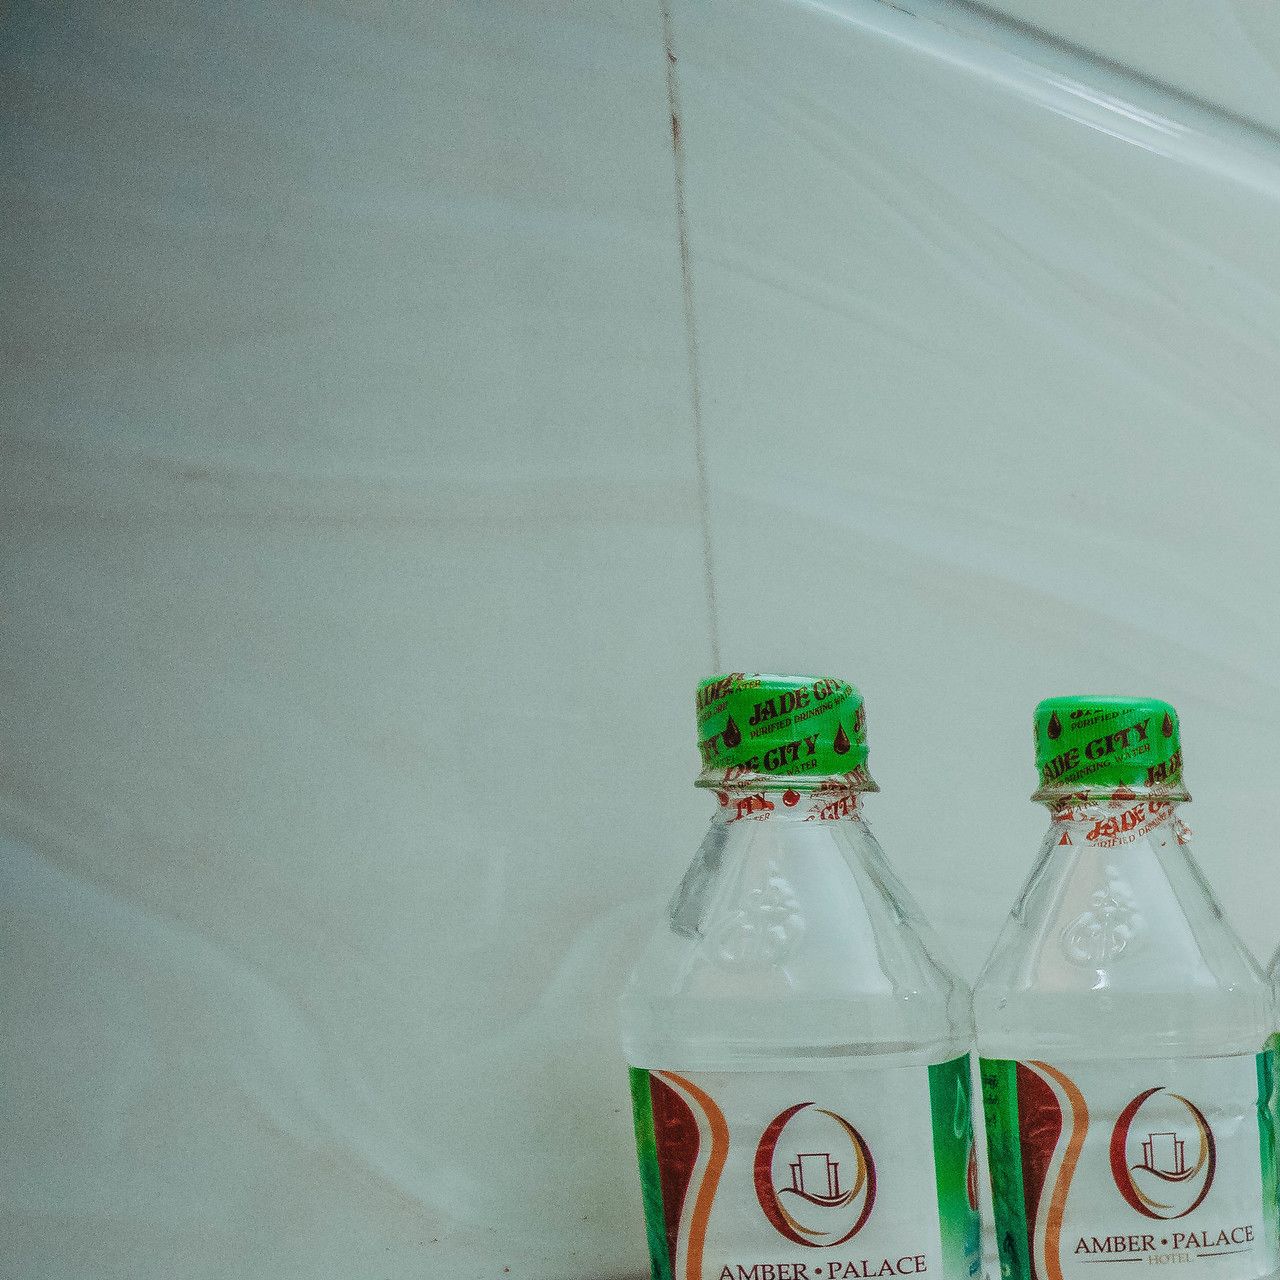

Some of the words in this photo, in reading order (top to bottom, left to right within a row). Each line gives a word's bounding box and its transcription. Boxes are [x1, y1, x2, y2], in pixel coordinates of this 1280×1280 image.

[749, 686, 810, 726] JADE
[813, 678, 843, 701] CIT
[763, 732, 820, 772] CITY
[1085, 717, 1151, 760] CITY
[1145, 749, 1182, 787] JAD
[1074, 1233, 1156, 1254] AMBER
[1172, 1225, 1255, 1250] PALACE
[828, 1254, 927, 1279] PALACE
